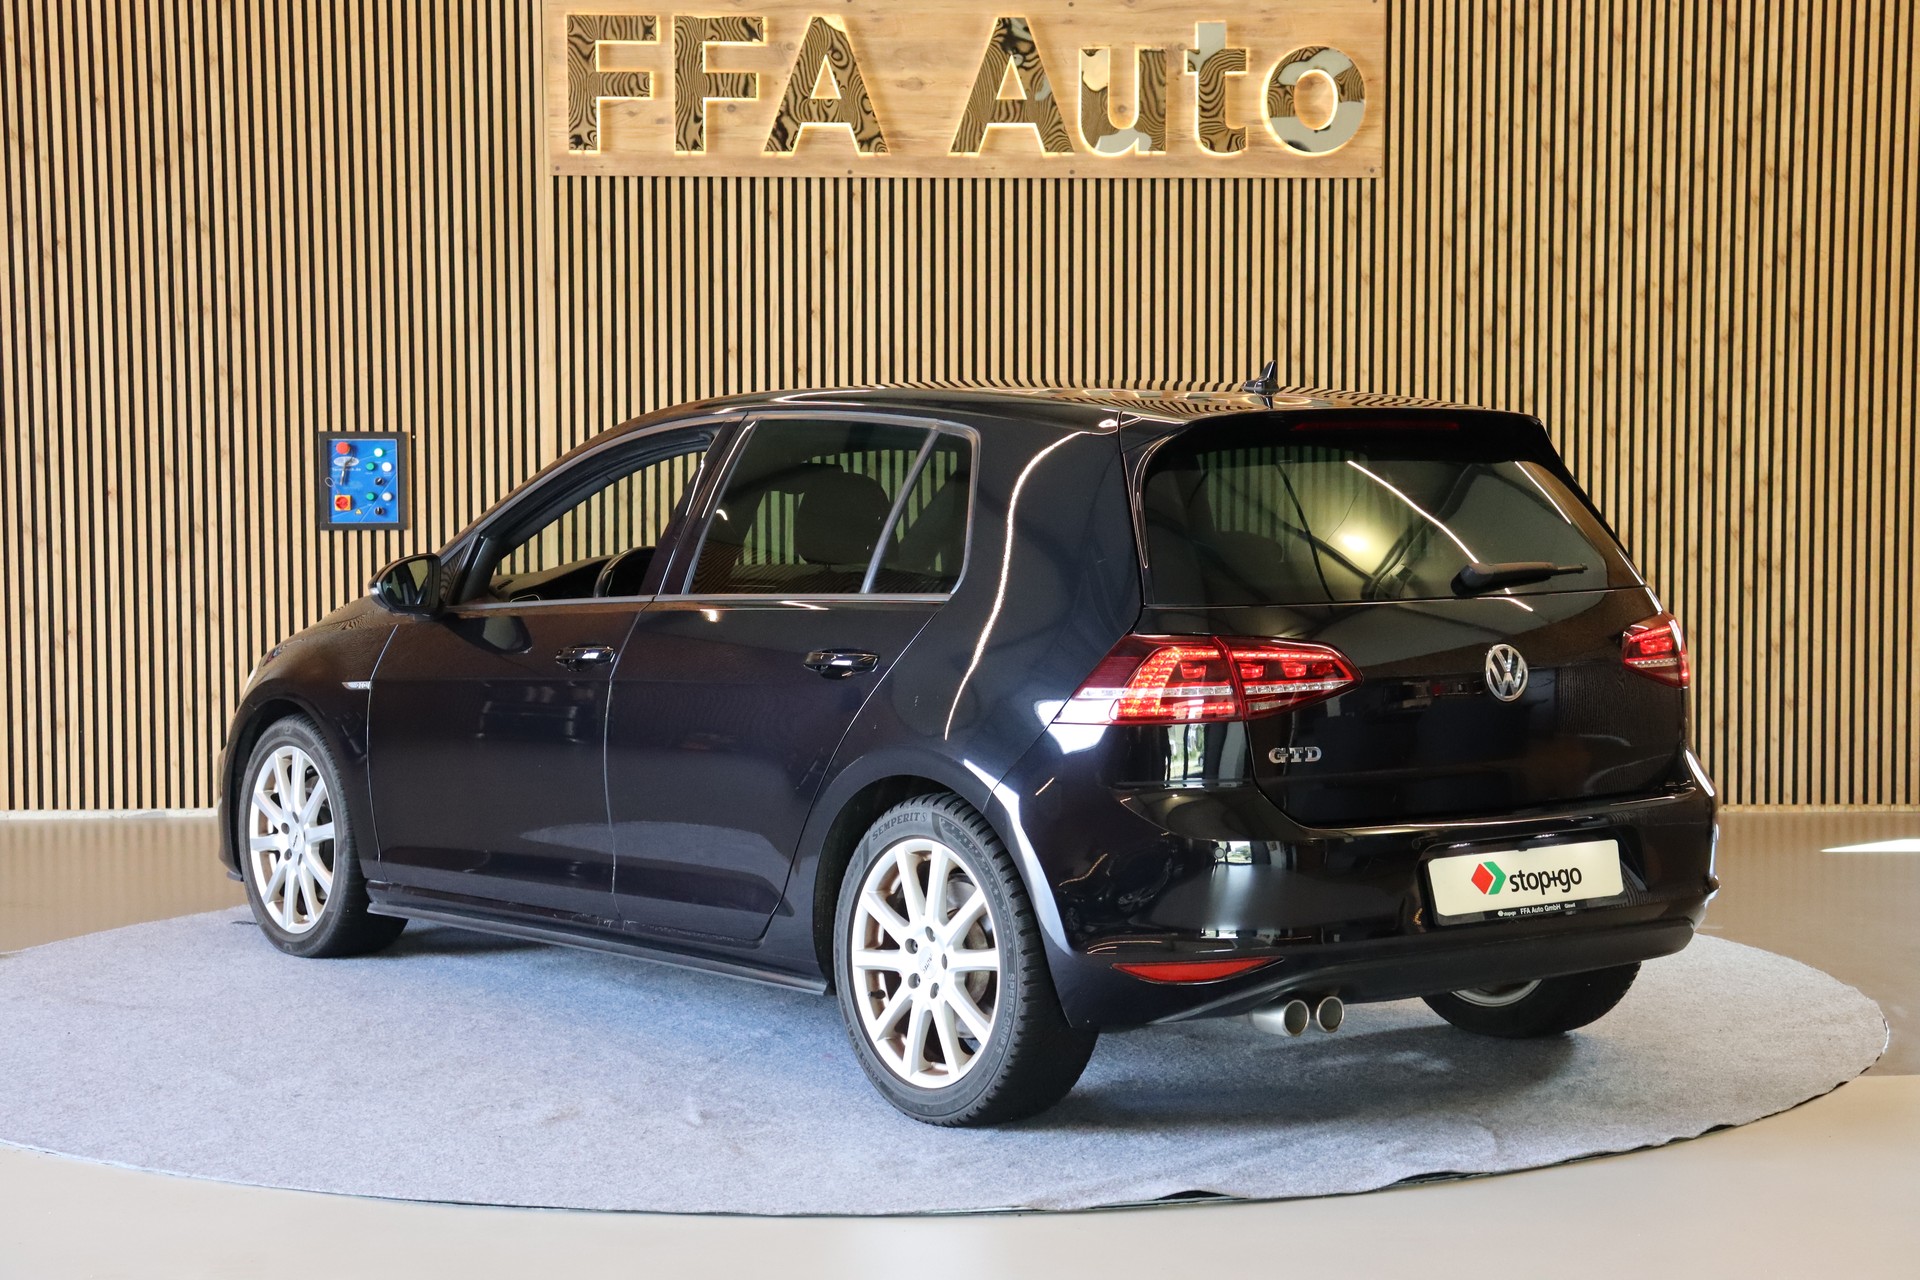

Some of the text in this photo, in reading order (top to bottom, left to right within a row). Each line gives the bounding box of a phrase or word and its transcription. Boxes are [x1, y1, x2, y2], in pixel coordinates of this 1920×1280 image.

[565, 14, 1367, 157] FFA Auto
[1268, 746, 1322, 764] GTD
[872, 812, 921, 840] SEMPERIT
[1509, 867, 1582, 895] stop+go
[1520, 907, 1531, 915] FFA
[1544, 903, 1561, 912] GmbH
[1000, 972, 1016, 1045] SPEED-GRIP
